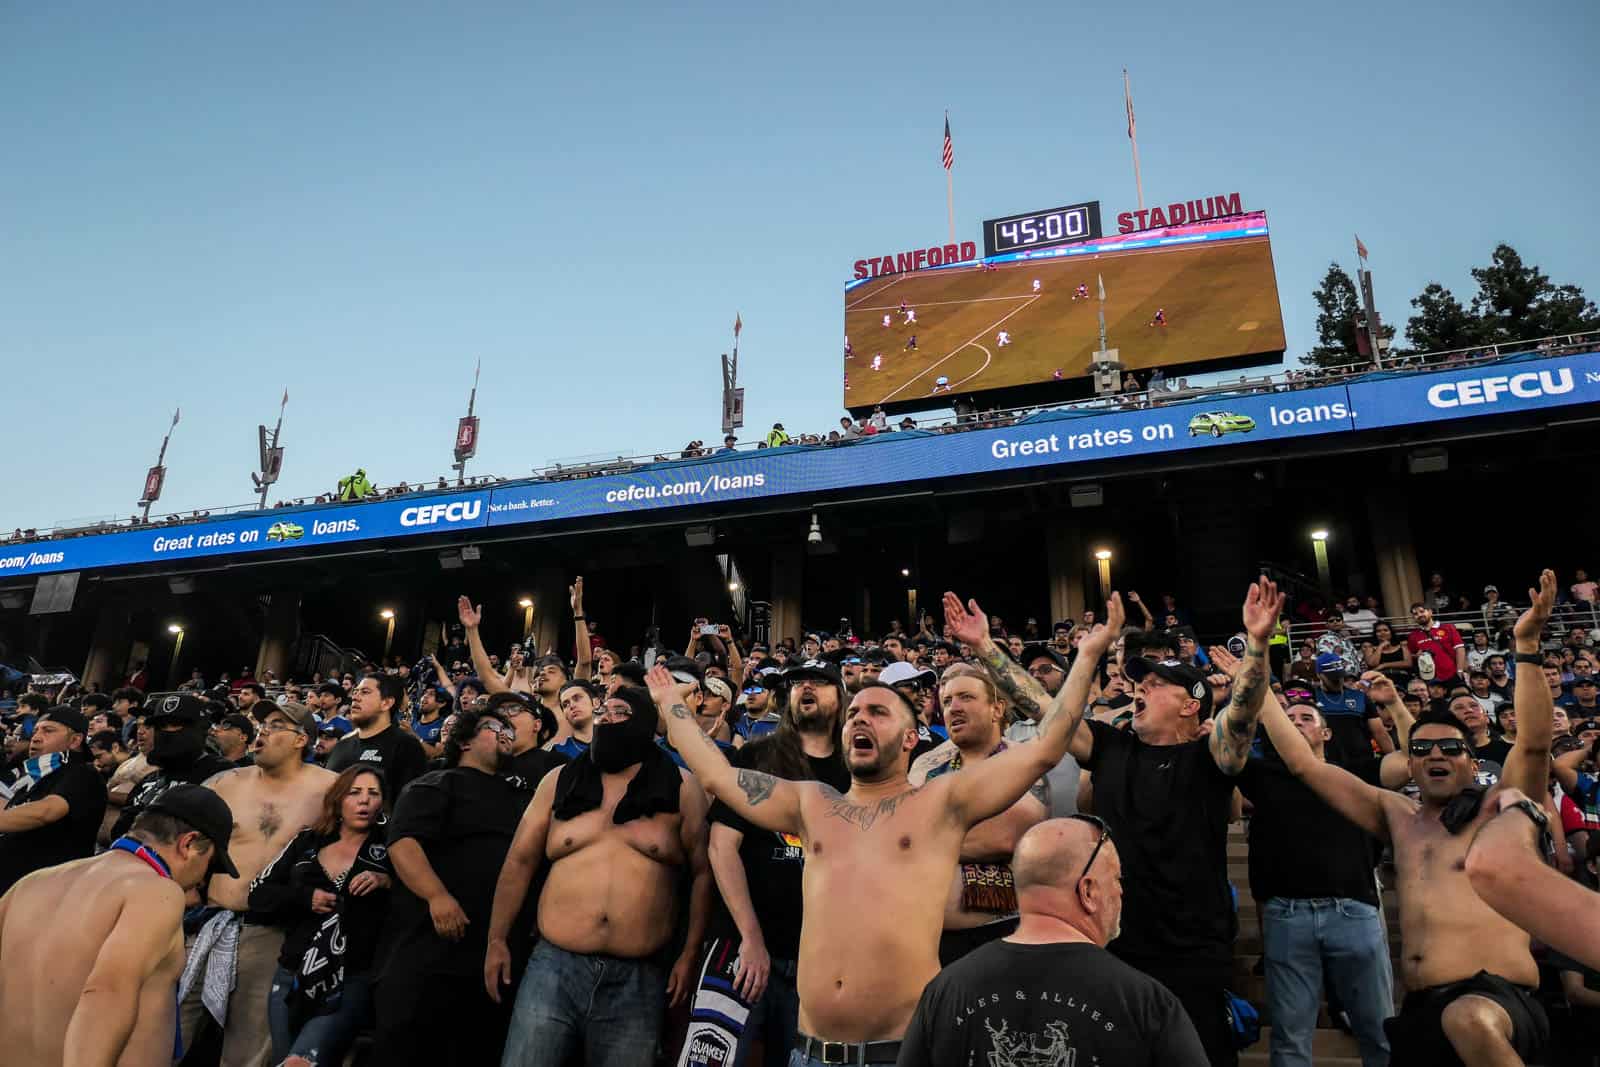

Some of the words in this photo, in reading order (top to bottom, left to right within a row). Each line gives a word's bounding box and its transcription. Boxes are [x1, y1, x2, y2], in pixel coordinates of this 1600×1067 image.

[1001, 210, 1083, 244] 45:00
[1118, 192, 1242, 234] STADIUM
[853, 241, 976, 279] STANFORD
[1427, 367, 1575, 408] CEFCU
[991, 435, 1060, 459] Great
[1068, 429, 1133, 451] rates
[1142, 423, 1174, 441] on
[1270, 403, 1357, 426] loans.
[605, 473, 765, 503] cefcu.com/loans
[400, 500, 481, 527] CEFCU
[153, 535, 194, 552] Great
[197, 532, 235, 548] rates
[239, 530, 259, 544] on
[312, 518, 361, 536] loans.
[955, 992, 1000, 1027] ALES
[1015, 990, 1027, 1001] &
[1040, 991, 1115, 1032] ALLIES
[692, 1038, 726, 1062] QUAKES
